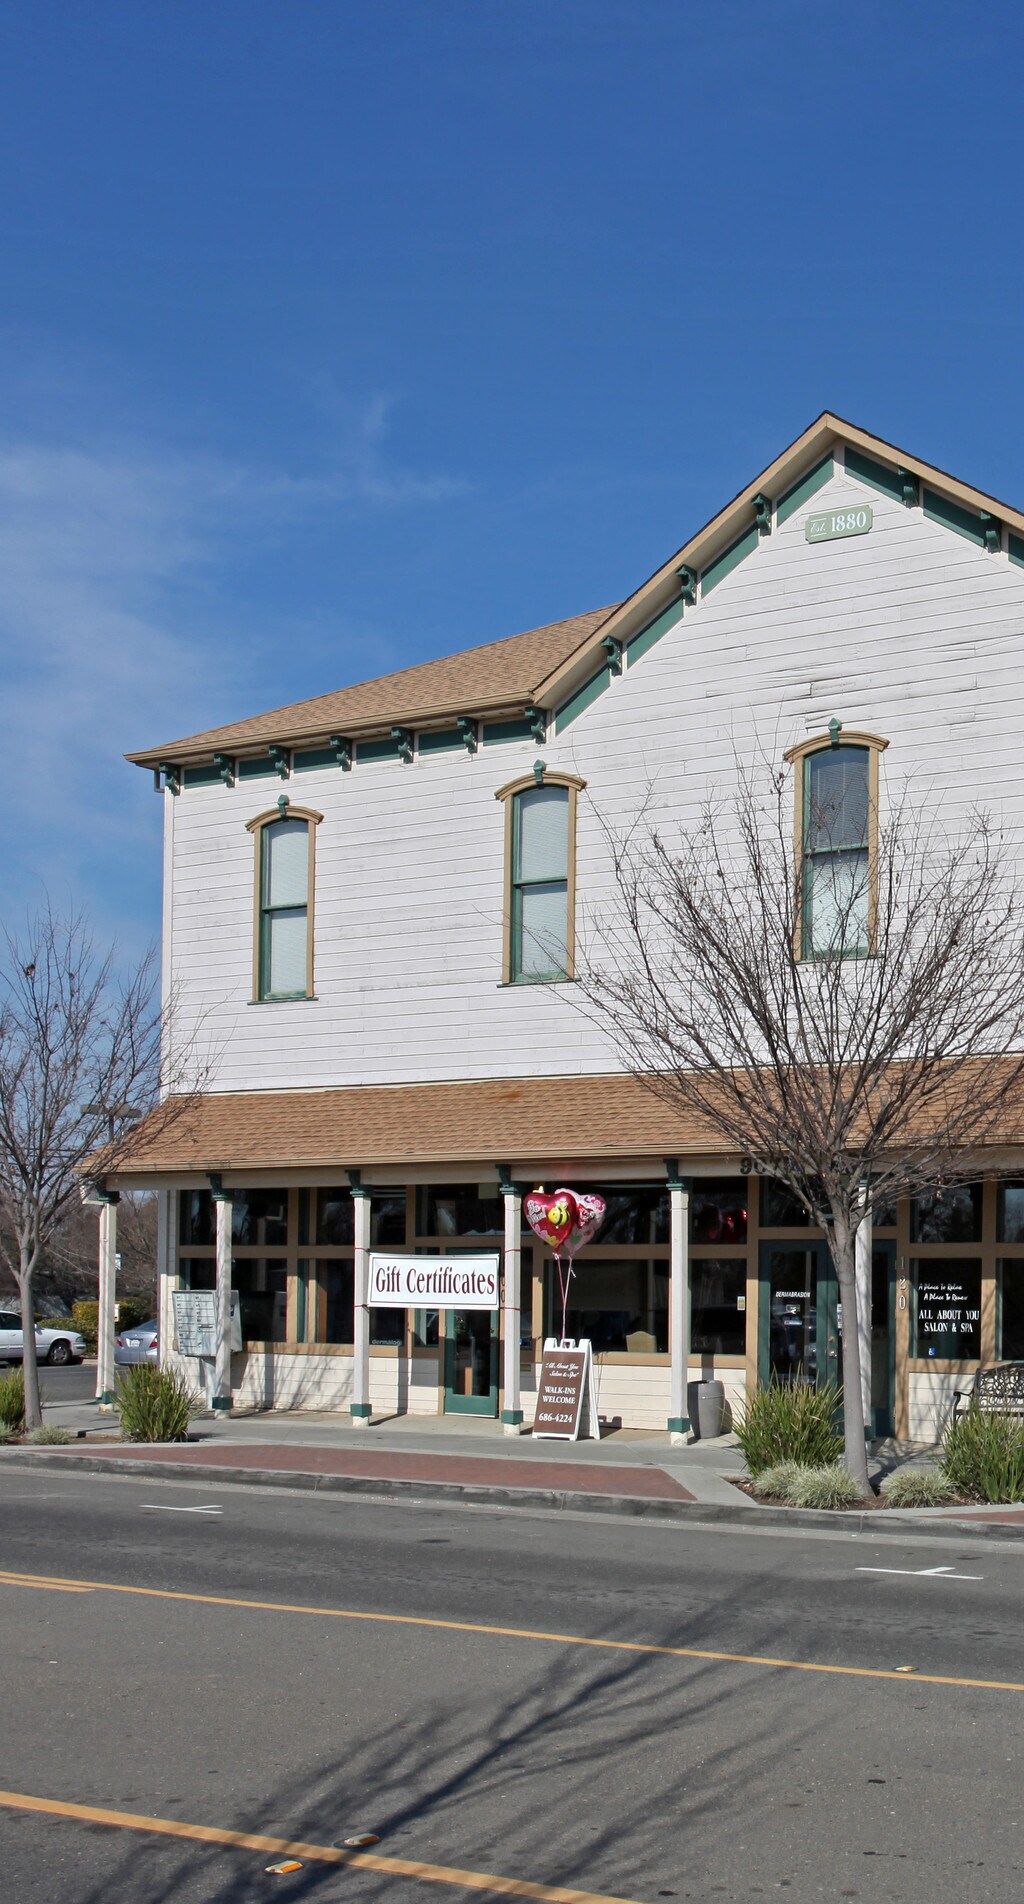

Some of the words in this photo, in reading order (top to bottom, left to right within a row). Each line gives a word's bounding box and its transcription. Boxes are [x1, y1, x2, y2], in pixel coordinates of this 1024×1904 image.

[810, 521, 826, 533] Est.
[831, 511, 867, 532] 1880
[376, 1265, 401, 1293] Gift
[406, 1266, 495, 1295] Certificates
[923, 1283, 939, 1291] Place
[947, 1283, 963, 1291] Relax
[929, 1292, 945, 1301] Place
[918, 1309, 934, 1320] ALL
[936, 1309, 962, 1320] ABOUT
[965, 1310, 980, 1321] YOU
[924, 1322, 949, 1332] SALON
[951, 1322, 957, 1333] &
[960, 1322, 974, 1333] SPA
[544, 1385, 577, 1395] WALK-INS
[542, 1395, 577, 1405] WELCOME
[538, 1412, 574, 1423] 686-4224
